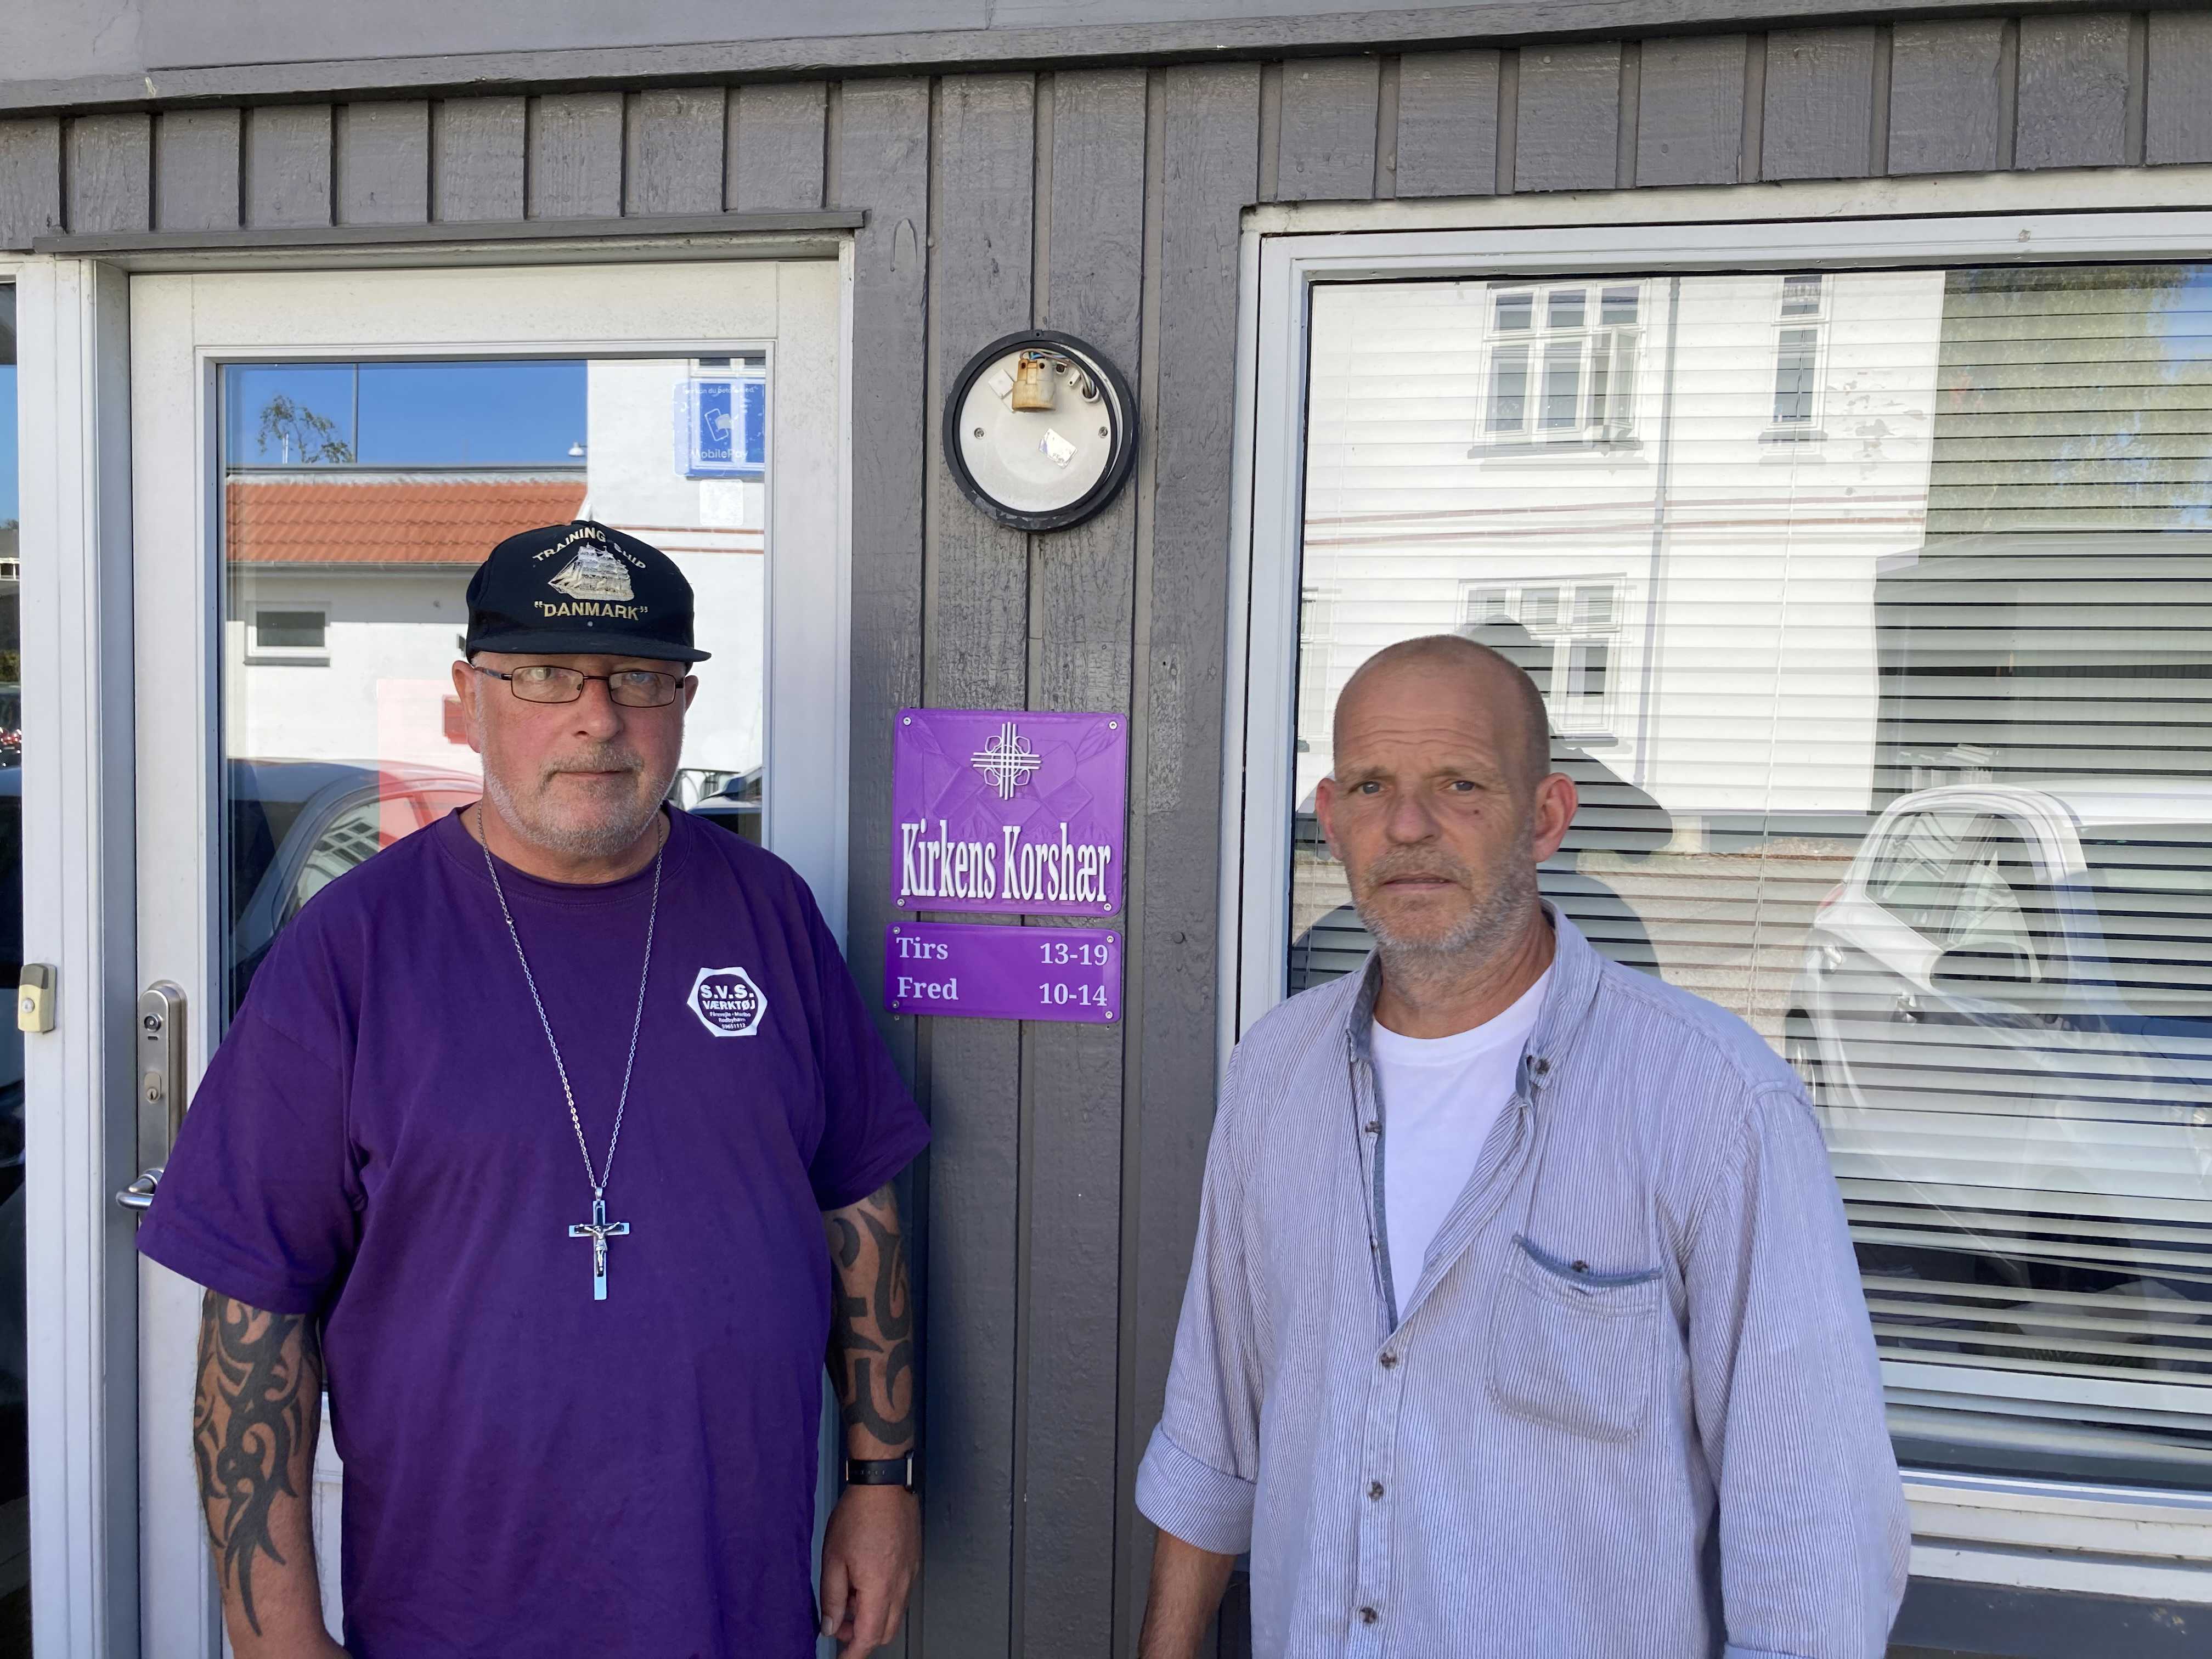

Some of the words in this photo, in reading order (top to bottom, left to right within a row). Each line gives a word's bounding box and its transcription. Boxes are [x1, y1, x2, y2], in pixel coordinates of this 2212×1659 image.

[692, 449, 748, 460] MobilePay
[532, 527, 606, 561] TRAINING
[900, 817, 997, 900] Kirkens
[1001, 822, 1111, 903] Korshær
[896, 936, 949, 960] Tirs
[1040, 943, 1109, 966] 13-19
[700, 984, 754, 999] S.V.S.
[702, 1000, 756, 1010] VÆRKTØJ
[896, 976, 959, 1001] Fred
[1039, 983, 1108, 1007] 10-14
